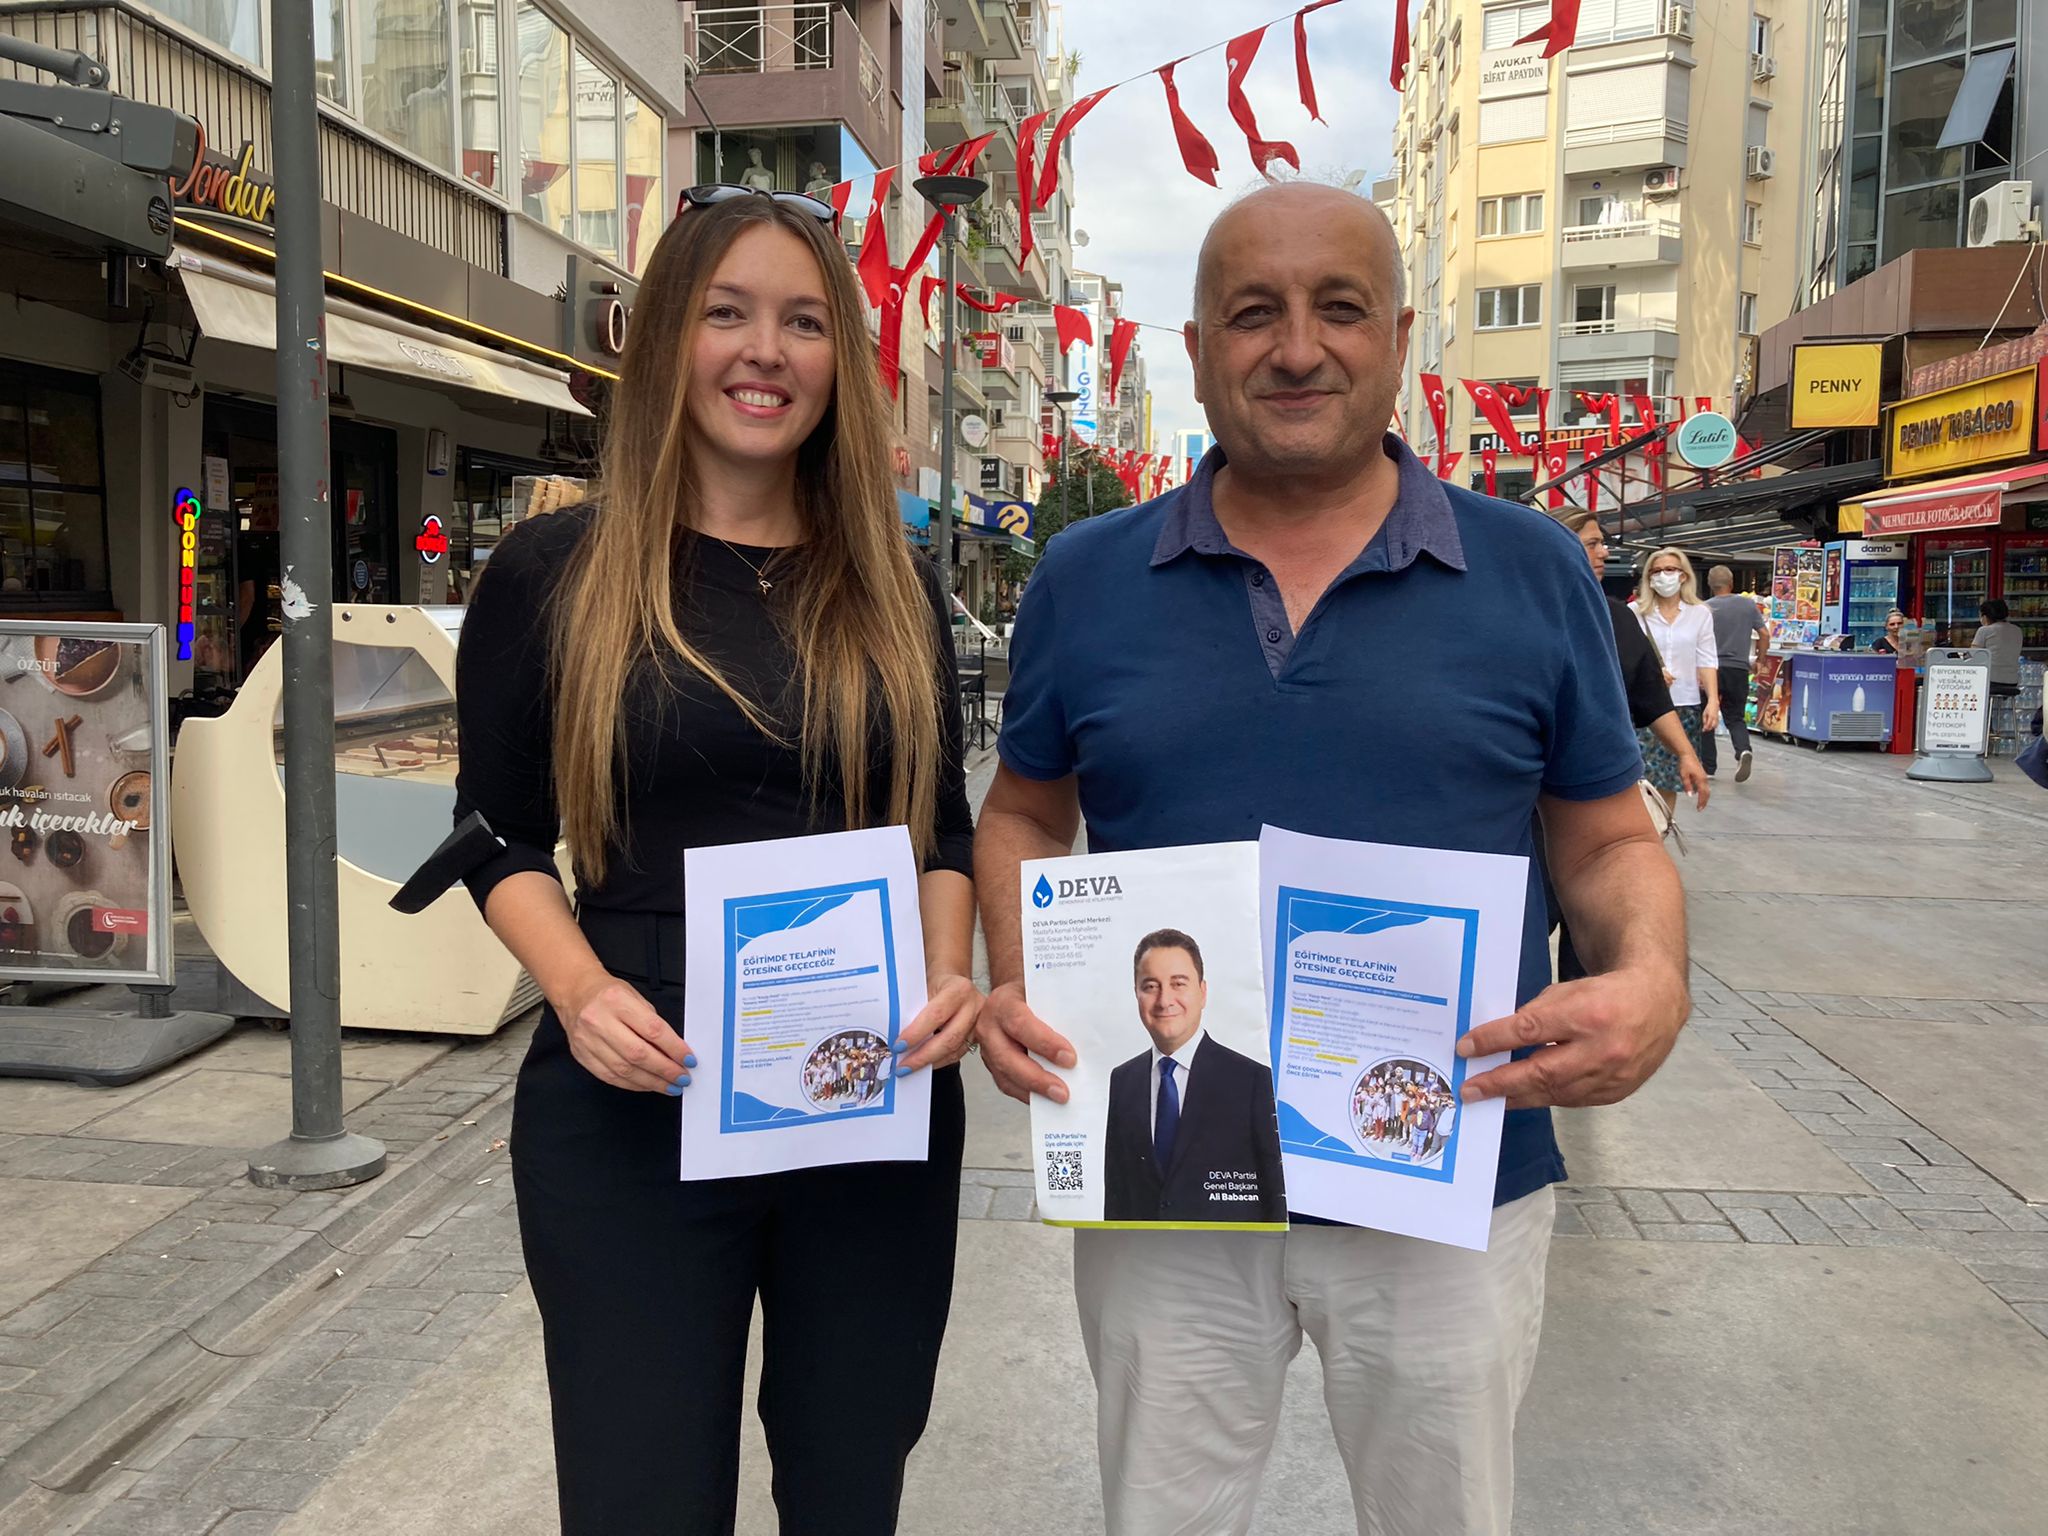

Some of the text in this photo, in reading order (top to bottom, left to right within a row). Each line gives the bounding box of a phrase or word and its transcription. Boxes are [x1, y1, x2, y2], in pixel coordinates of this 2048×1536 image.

[1493, 56, 1533, 69] AVUKAT
[1508, 67, 1544, 81] APAYDIN
[1810, 378, 1862, 394] PENNY
[1900, 416, 1945, 452] PENNY
[1948, 399, 2015, 442] TOBACCO
[1479, 432, 1538, 451] clic
[1687, 428, 1729, 445] Latife
[1881, 511, 1927, 529] MEHMETLER
[1861, 544, 1892, 553] damla
[12, 788, 52, 800] havaları
[53, 792, 92, 803] ısıtacak
[30, 807, 139, 837] içecekler
[1058, 876, 1122, 899] DEVA
[1032, 920, 1049, 928] DEVA
[743, 947, 836, 966] EĞİTİMDE TELAFİNİN
[1294, 949, 1397, 973] EĞİTİMDE TELAFİNİN
[743, 958, 835, 976] ÖTESİNE GEÇECEĞİZ
[1294, 961, 1395, 983] ÖTESİNE GEÇECEĞİZ
[1209, 1171, 1257, 1180] DEVA Partisi
[1203, 1181, 1258, 1192] Genel Başkanı
[1209, 1192, 1259, 1201] Ali Babacan
